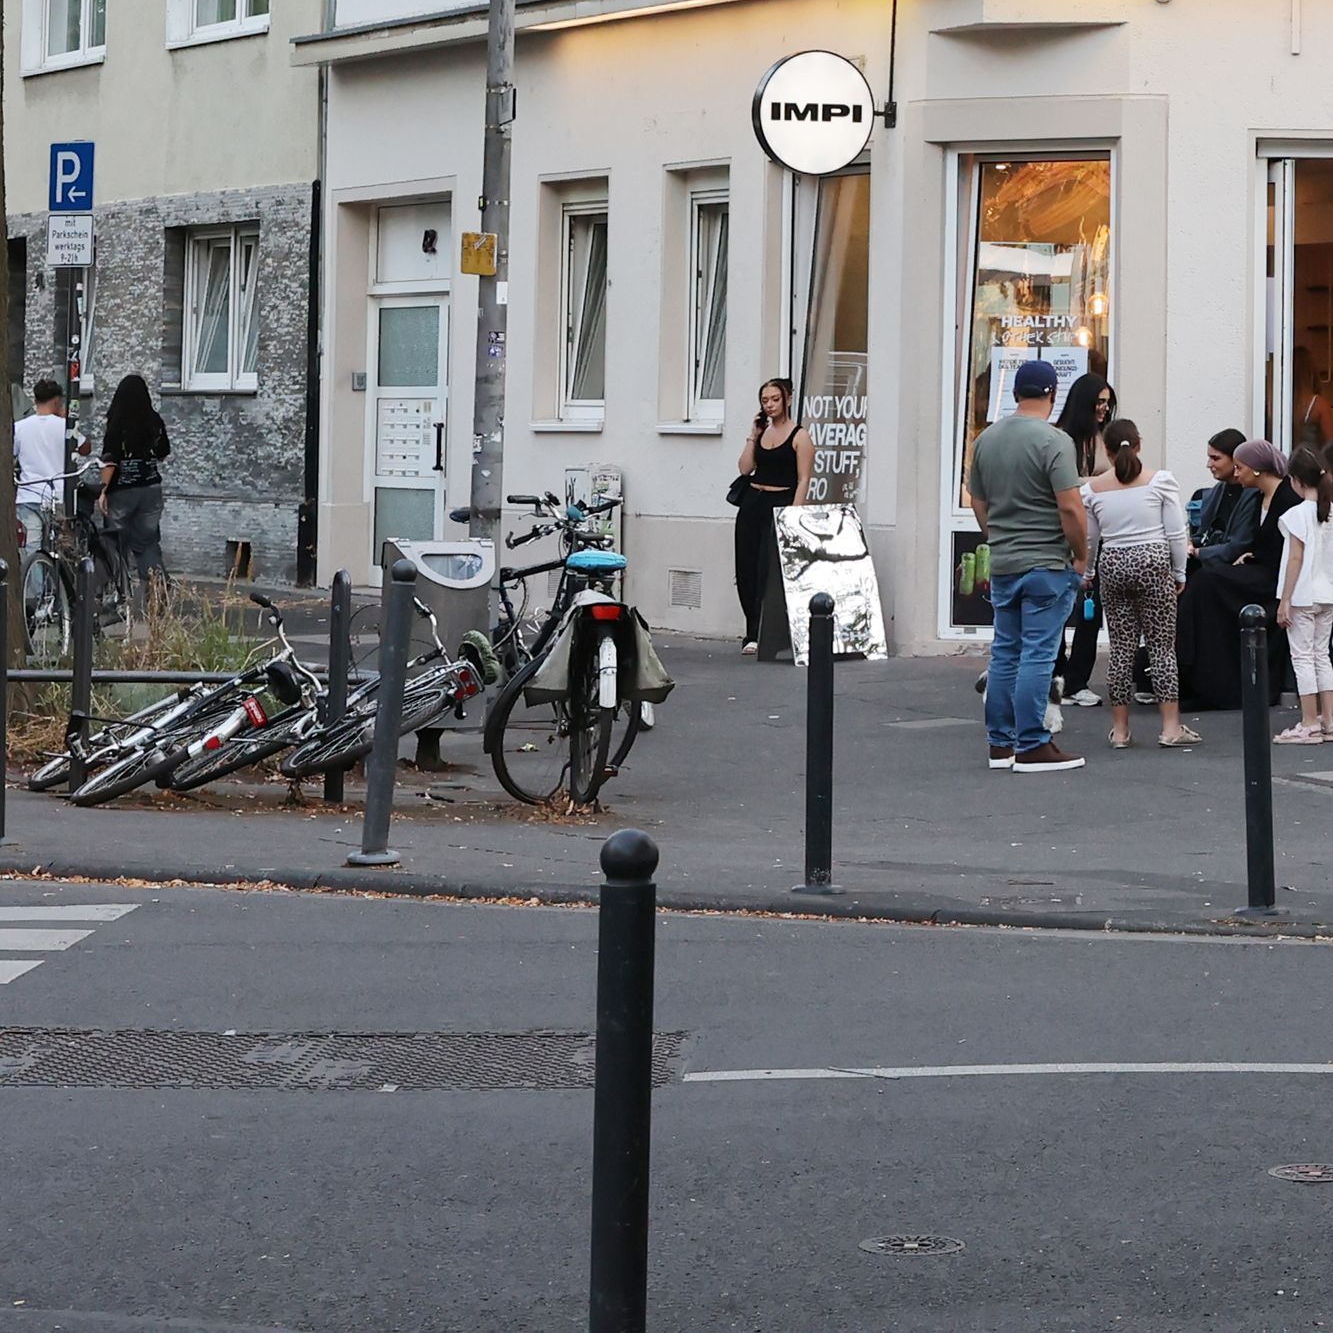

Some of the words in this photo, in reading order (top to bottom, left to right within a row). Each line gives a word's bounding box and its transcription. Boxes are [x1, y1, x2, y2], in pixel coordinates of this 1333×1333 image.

[771, 102, 862, 123] IMPI
[56, 151, 81, 203] P
[64, 218, 76, 227] mit
[51, 229, 89, 239] Parkschein
[54, 242, 85, 253] werktags
[1001, 315, 1077, 328] HEALTHY
[803, 395, 833, 419] NOT
[813, 450, 861, 478] STUFF,
